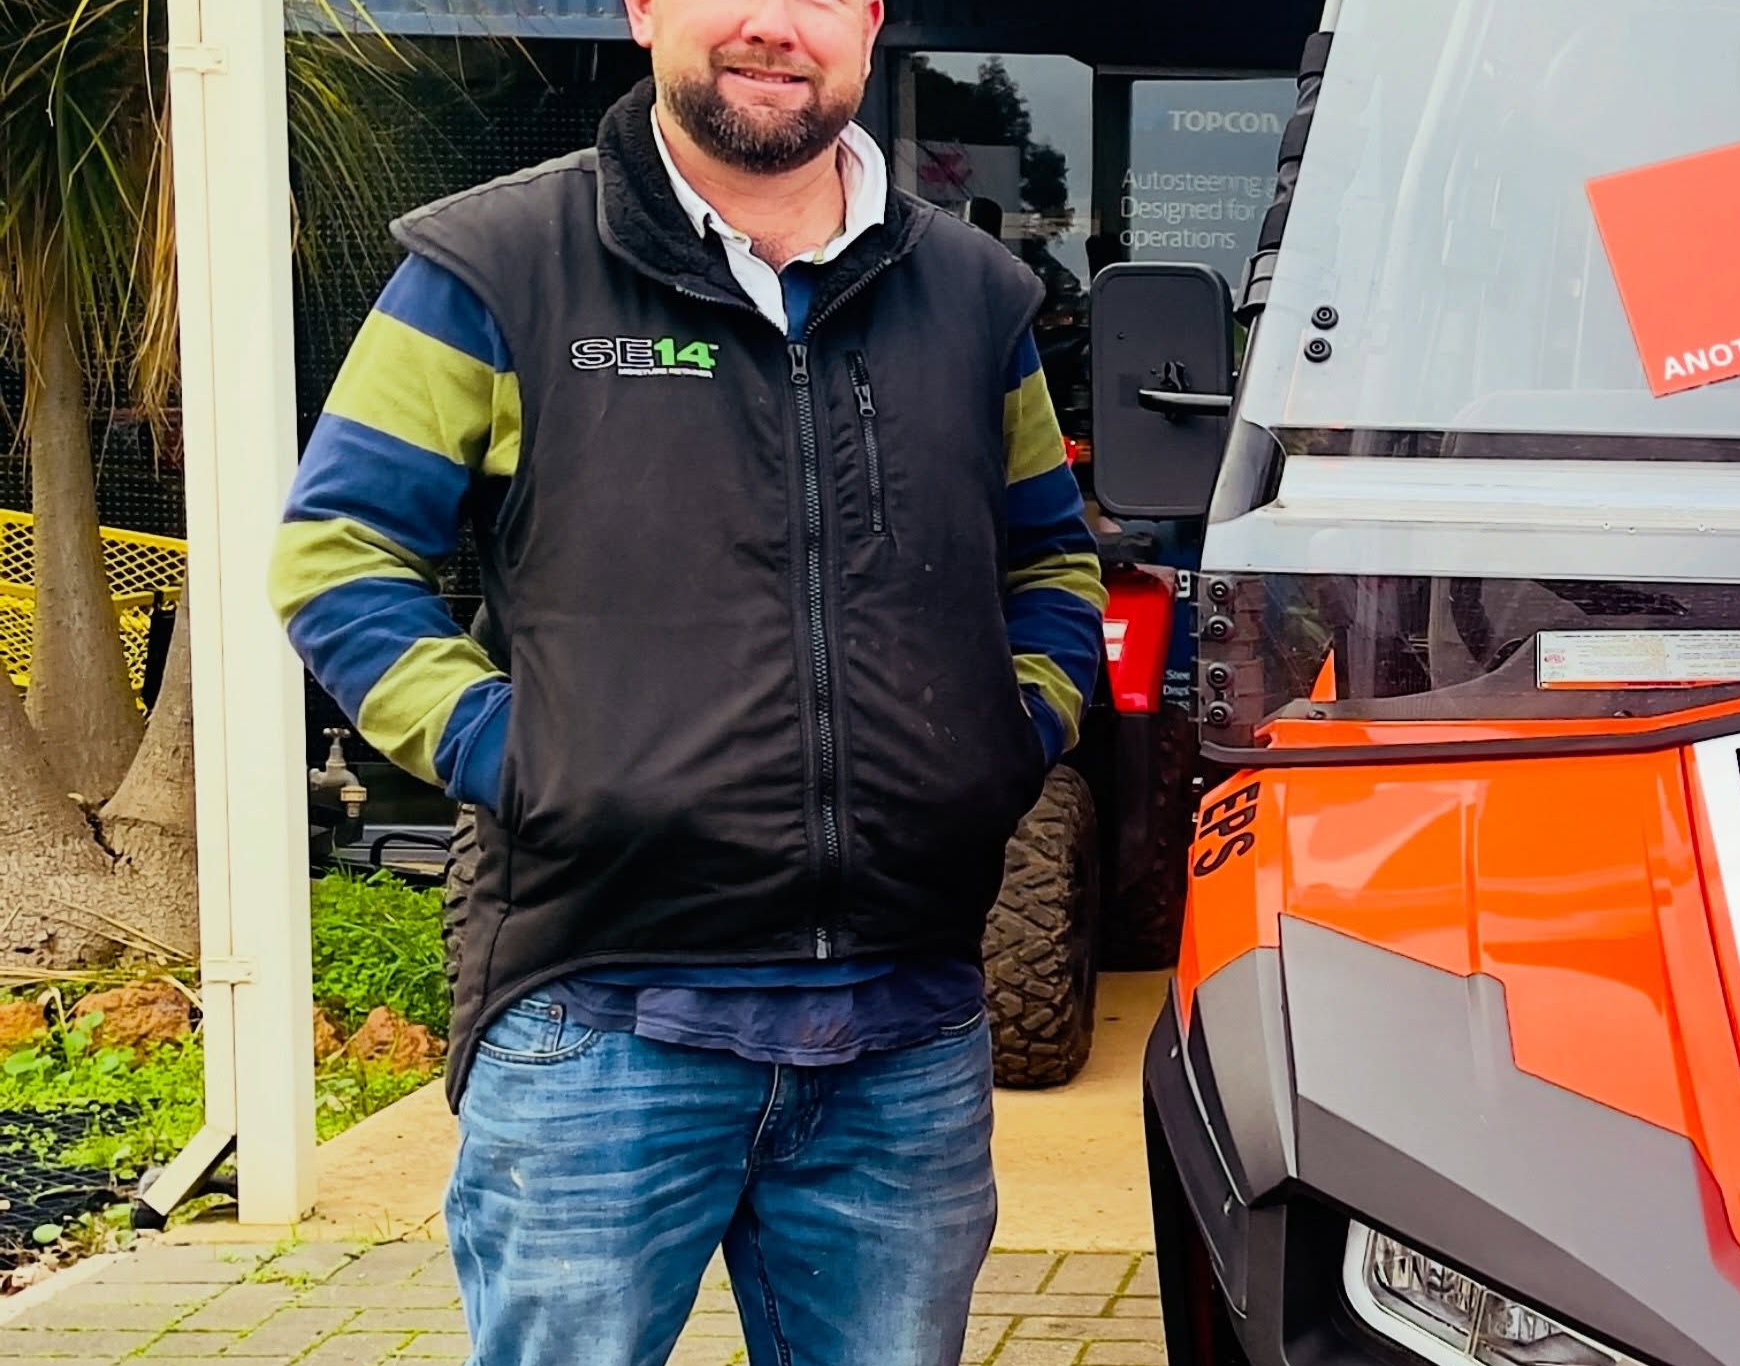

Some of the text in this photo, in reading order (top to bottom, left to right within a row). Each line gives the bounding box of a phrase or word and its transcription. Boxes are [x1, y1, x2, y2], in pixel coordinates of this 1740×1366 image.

[1121, 169, 1262, 198] Autosteering
[1120, 196, 1257, 225] Designed for
[1192, 781, 1262, 878] EPS
